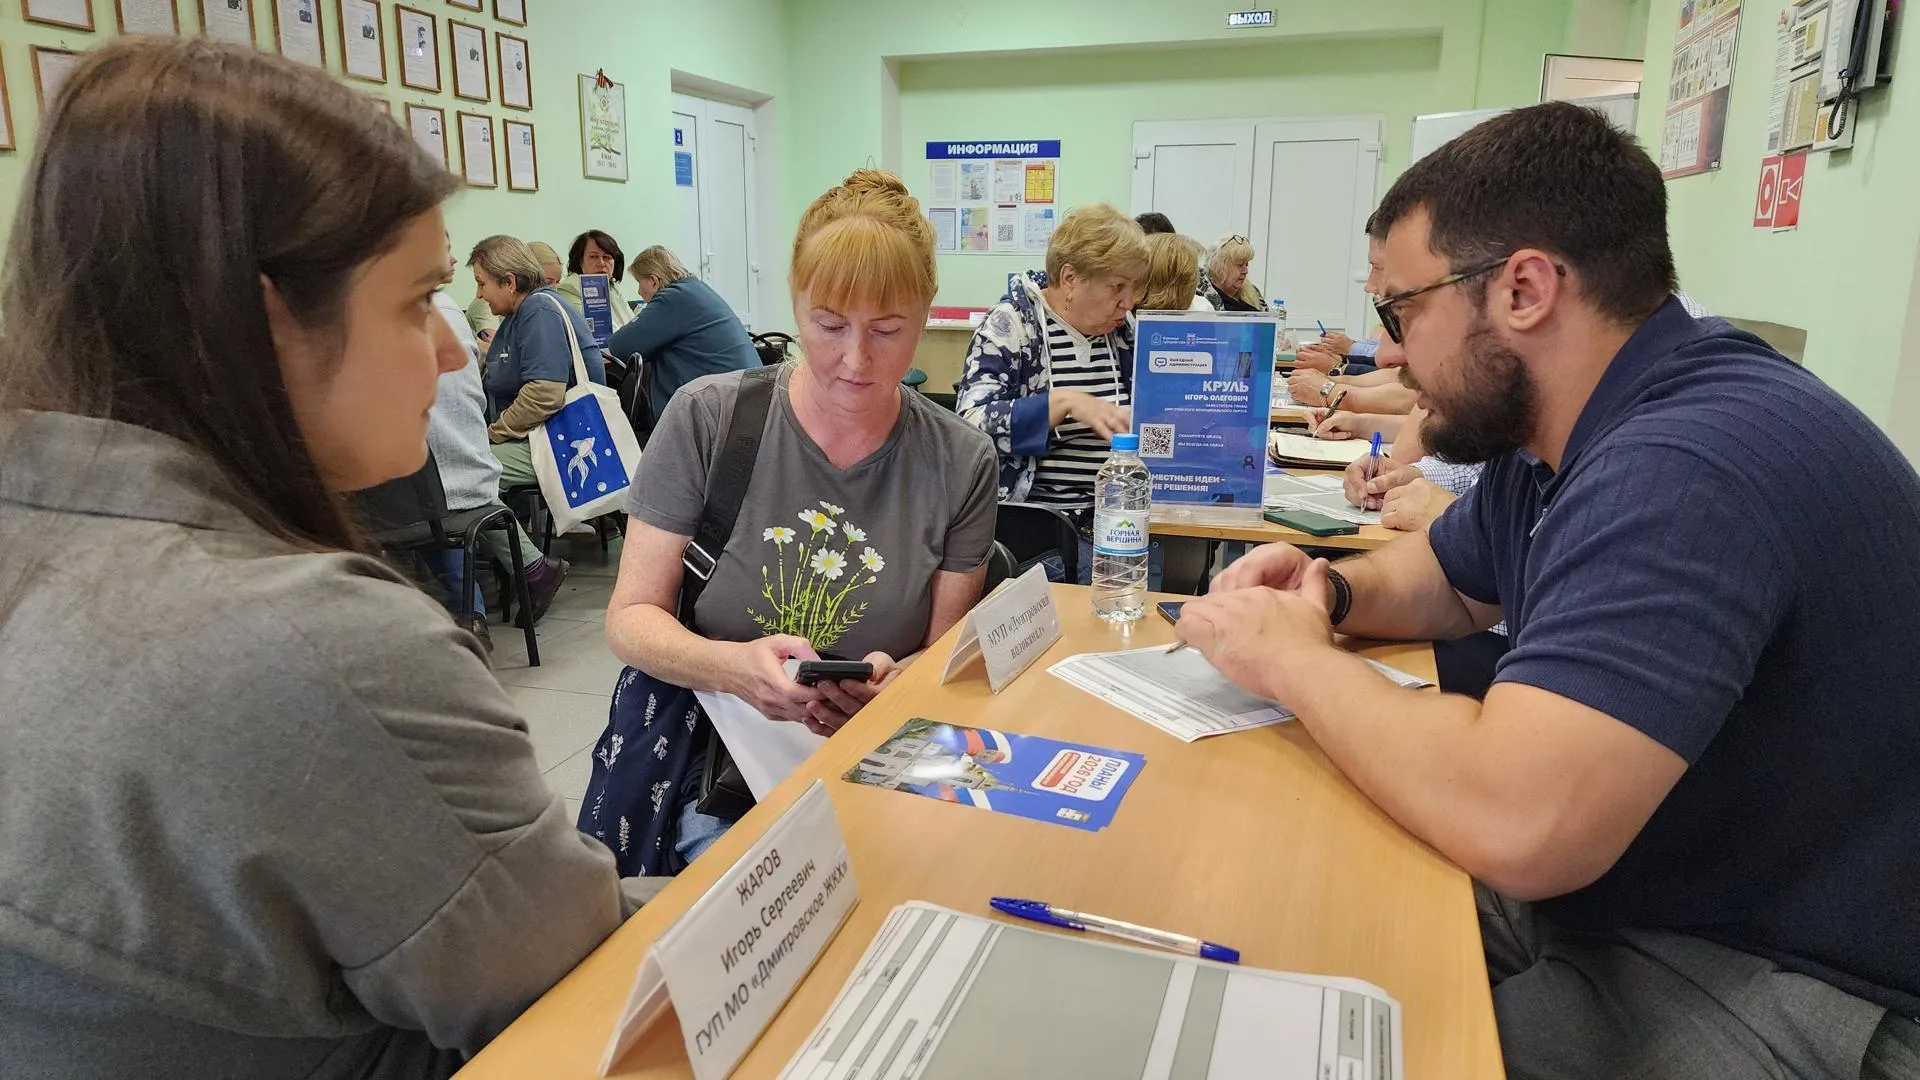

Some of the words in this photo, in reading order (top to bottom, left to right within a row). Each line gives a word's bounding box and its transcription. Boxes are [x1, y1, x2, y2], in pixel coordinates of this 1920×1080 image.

[1230, 12, 1270, 25] ВЫХОД
[947, 143, 1038, 155] ИНФОРМАЦИЯ
[1202, 380, 1249, 393] КРУЛЬ
[1184, 393, 1209, 401] ИГОРЬ
[1194, 476, 1220, 484] ИДЕИ
[1163, 484, 1209, 492] РЕШЕНИЯ!
[1106, 535, 1142, 544] ВЕРШИНА
[1111, 529, 1140, 537] ГОРНАЯ
[987, 623, 1008, 648] МУП
[1077, 755, 1102, 777] 2026
[1089, 759, 1122, 791] ПЛАНЫ
[1059, 775, 1086, 794] ГОД
[735, 848, 781, 906] ЖАРОВ
[720, 925, 762, 974] Игорь
[760, 858, 816, 927] Сергеевич
[694, 1015, 726, 1056] ГУП
[724, 982, 750, 1023] МО
[750, 892, 825, 990] «Дмитровское
[823, 860, 849, 901] ЖКХ»
